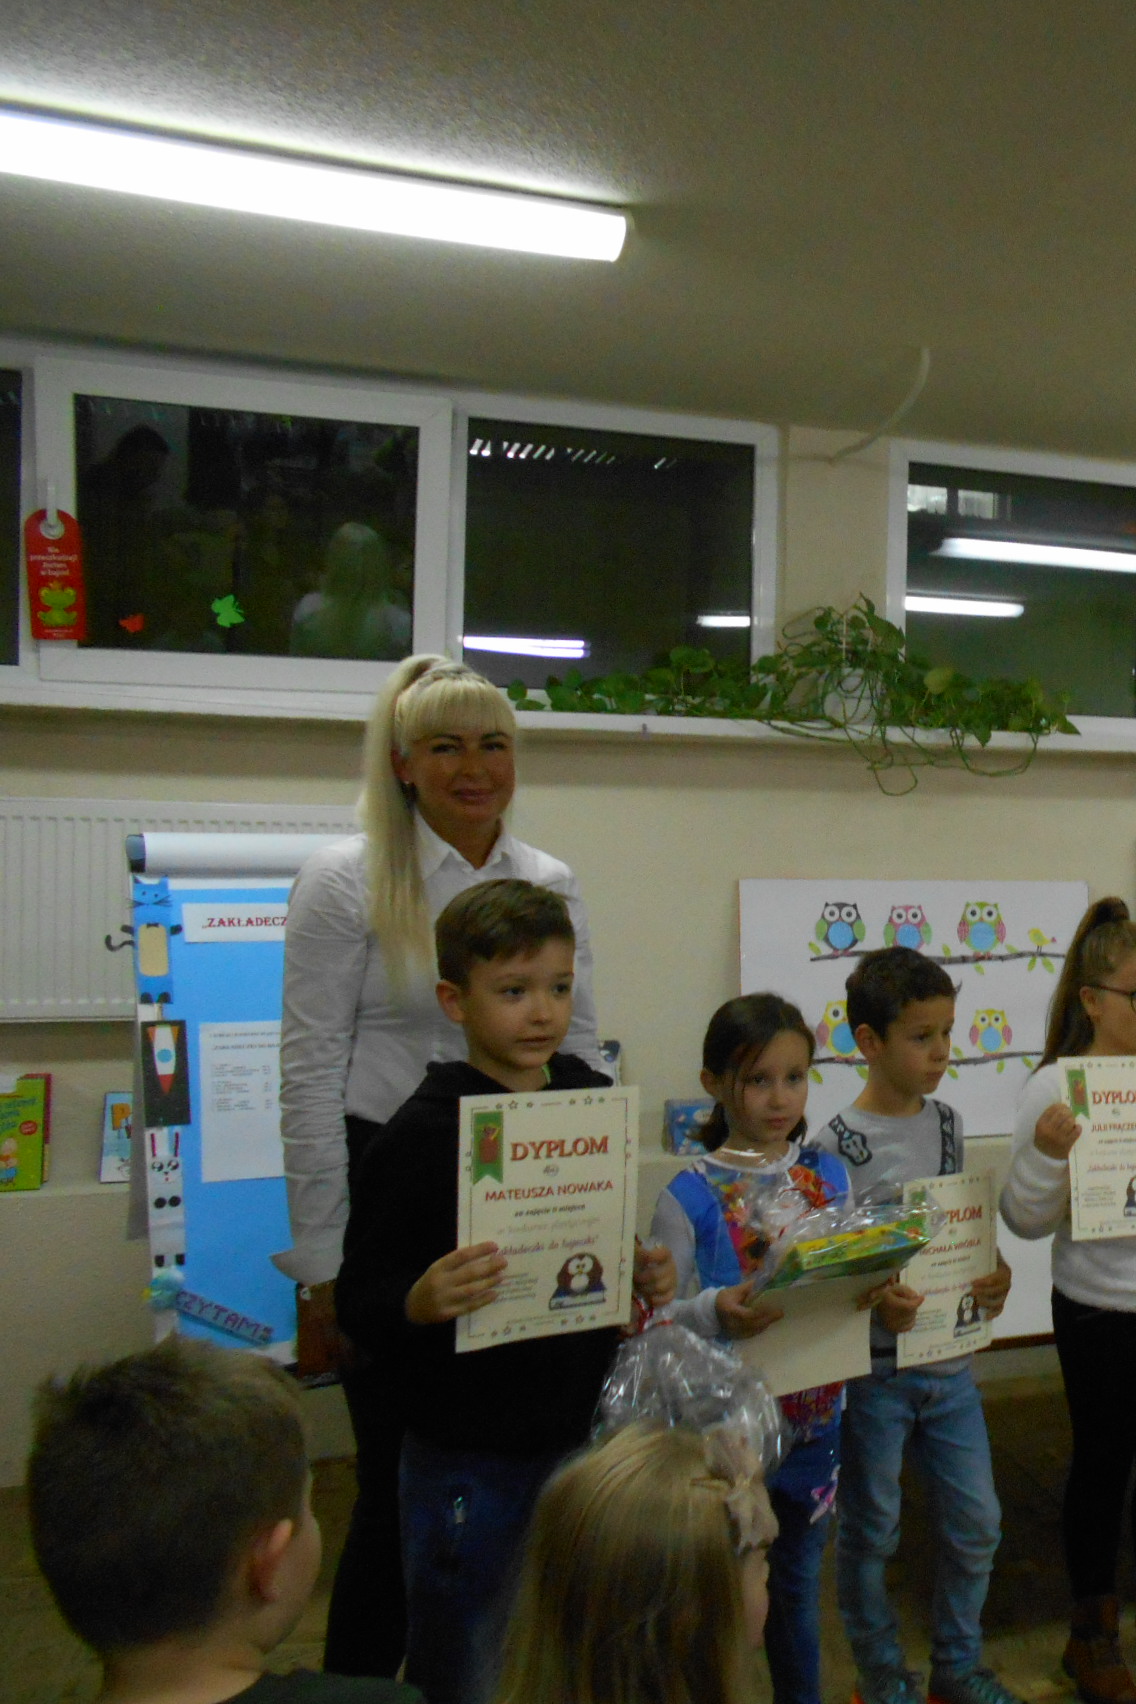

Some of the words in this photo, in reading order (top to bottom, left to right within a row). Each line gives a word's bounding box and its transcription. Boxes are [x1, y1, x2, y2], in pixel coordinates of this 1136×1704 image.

[510, 1135, 609, 1162] DYPLOM
[485, 1186, 554, 1201] MATEUSZA
[557, 1180, 614, 1195] NOWAKA
